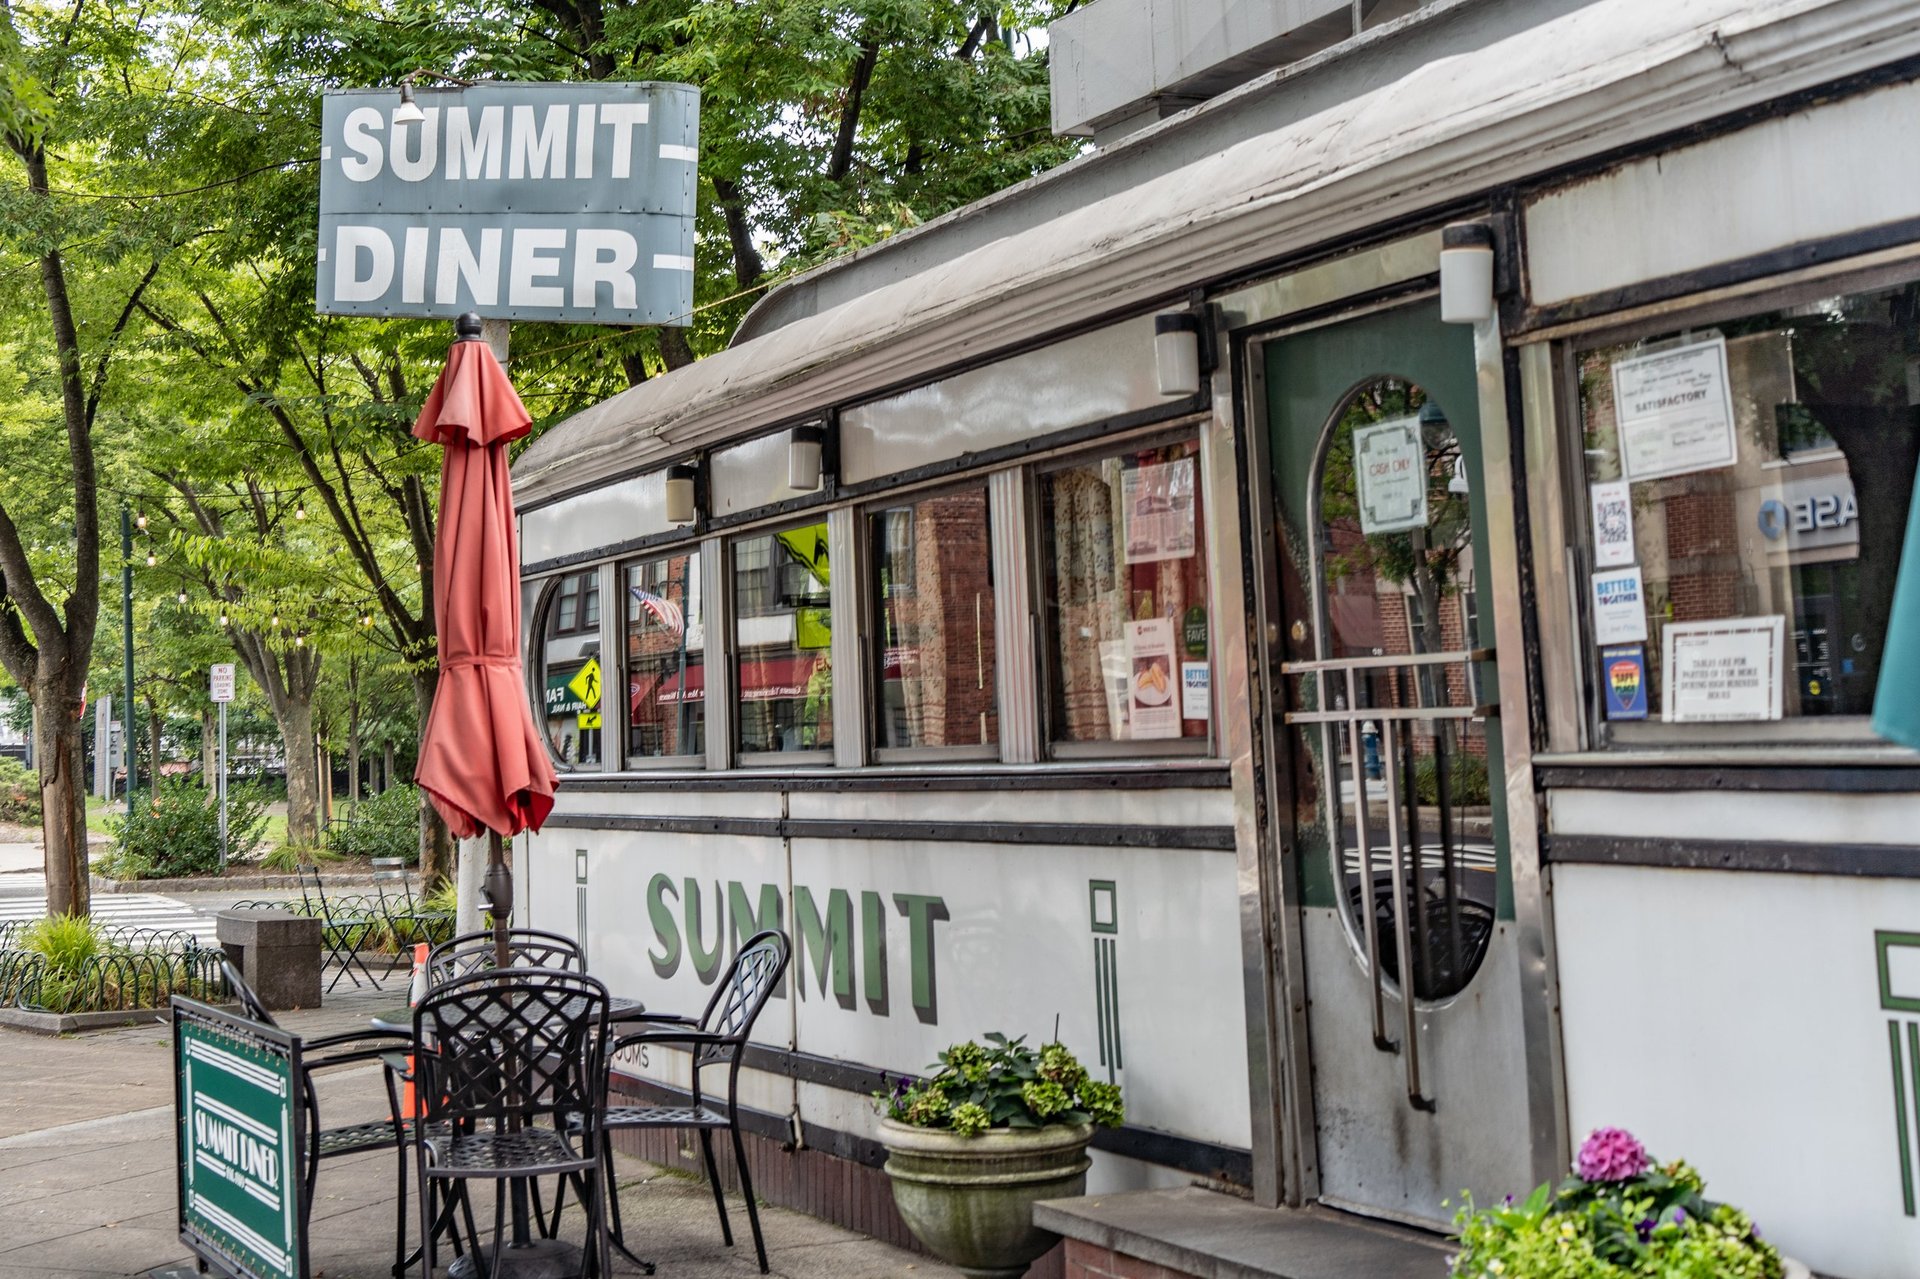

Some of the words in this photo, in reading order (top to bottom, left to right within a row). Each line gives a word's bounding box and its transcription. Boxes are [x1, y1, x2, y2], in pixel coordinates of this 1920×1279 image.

[340, 103, 648, 183] SUMMIT
[334, 225, 638, 310] DINER
[1635, 389, 1707, 414] SATISFACTORY
[1369, 463, 1389, 477] CASH
[1392, 458, 1410, 473] ONLY
[1597, 578, 1636, 595] BETTER
[1598, 593, 1638, 606] TOGETHER
[1186, 628, 1207, 642] FAVE
[213, 674, 233, 682] PARKING
[1185, 668, 1209, 681] BETTE
[647, 872, 950, 1027] SUMMIT
[195, 1109, 240, 1165] SUMMIT
[240, 1133, 279, 1190] DINER
